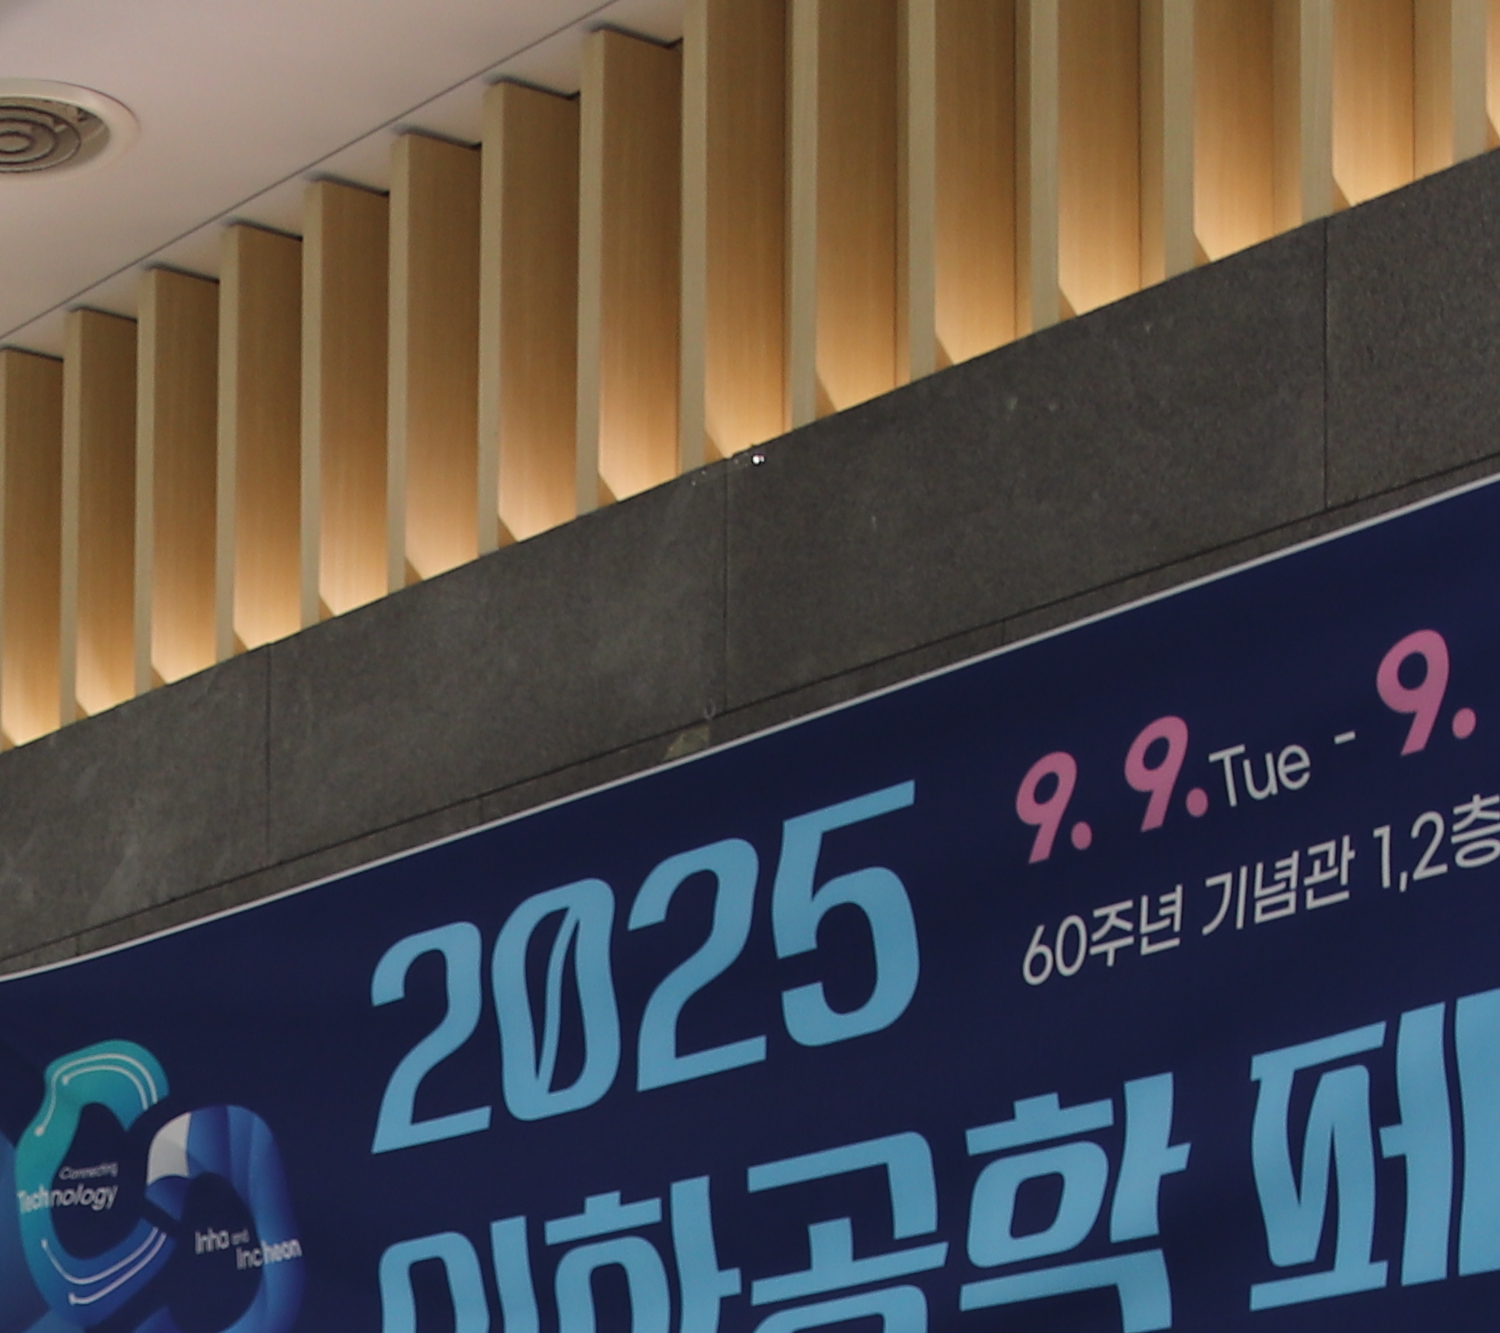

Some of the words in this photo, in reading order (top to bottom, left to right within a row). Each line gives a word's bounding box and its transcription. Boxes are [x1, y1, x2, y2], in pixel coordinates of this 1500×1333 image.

[1021, 882, 1183, 987] 60주년
[1201, 836, 1357, 937] 기념관
[370, 780, 922, 1154] 2025
[16, 1184, 119, 1214] Technology
[195, 1227, 231, 1256] Inha
[235, 1239, 303, 1271] Incheon
